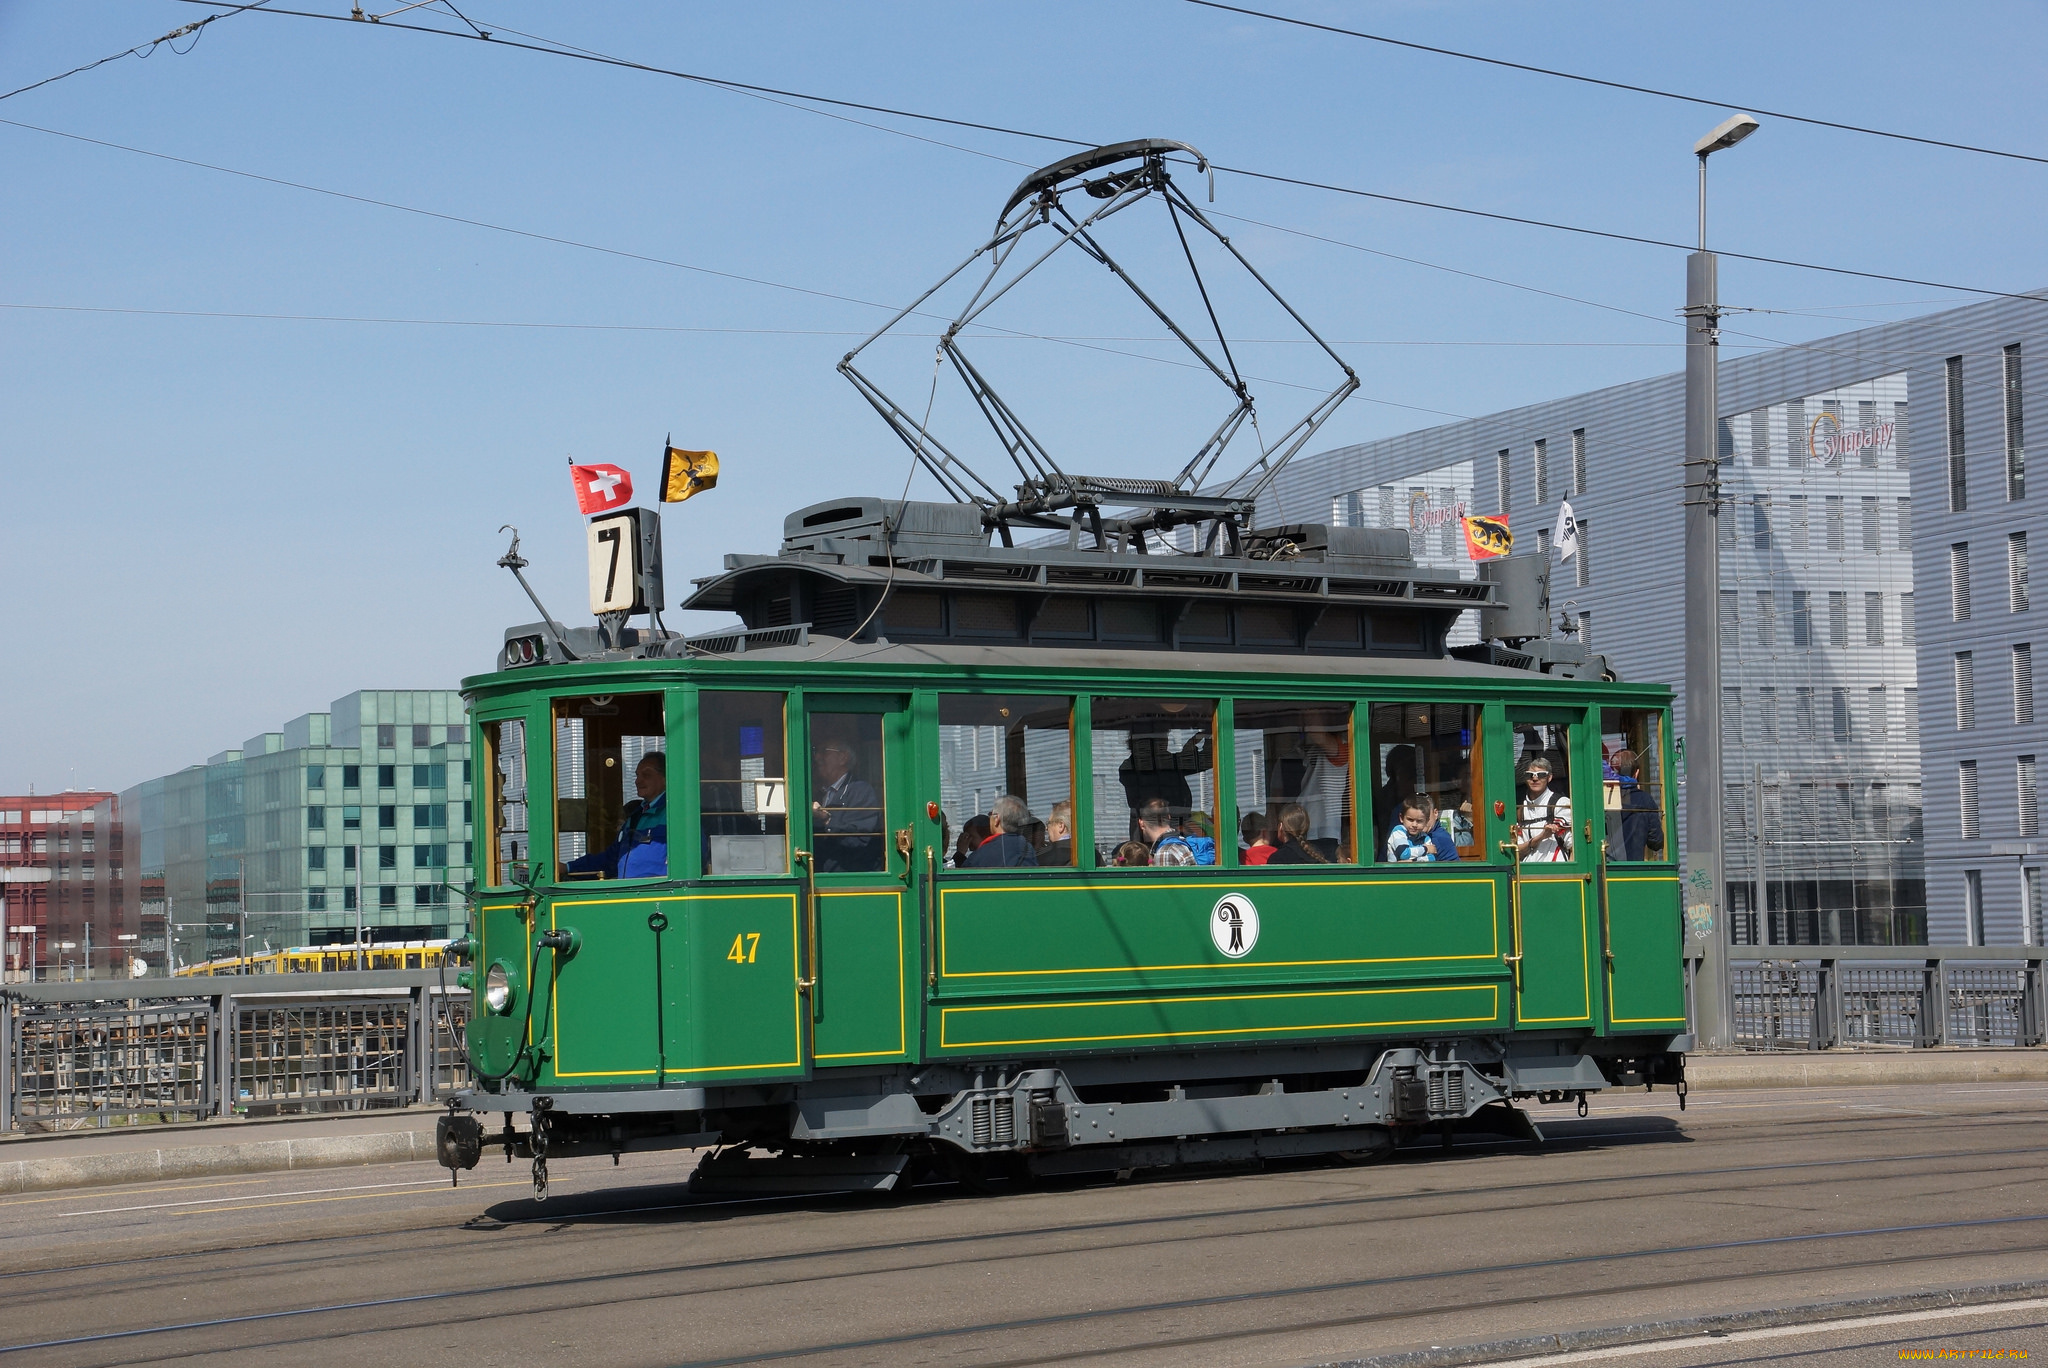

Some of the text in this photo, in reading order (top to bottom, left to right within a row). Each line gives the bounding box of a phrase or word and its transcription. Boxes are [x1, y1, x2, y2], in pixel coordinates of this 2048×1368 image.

[597, 526, 621, 603] 7
[764, 781, 776, 807] 7
[1606, 783, 1615, 805] 7
[727, 932, 761, 964] 47
